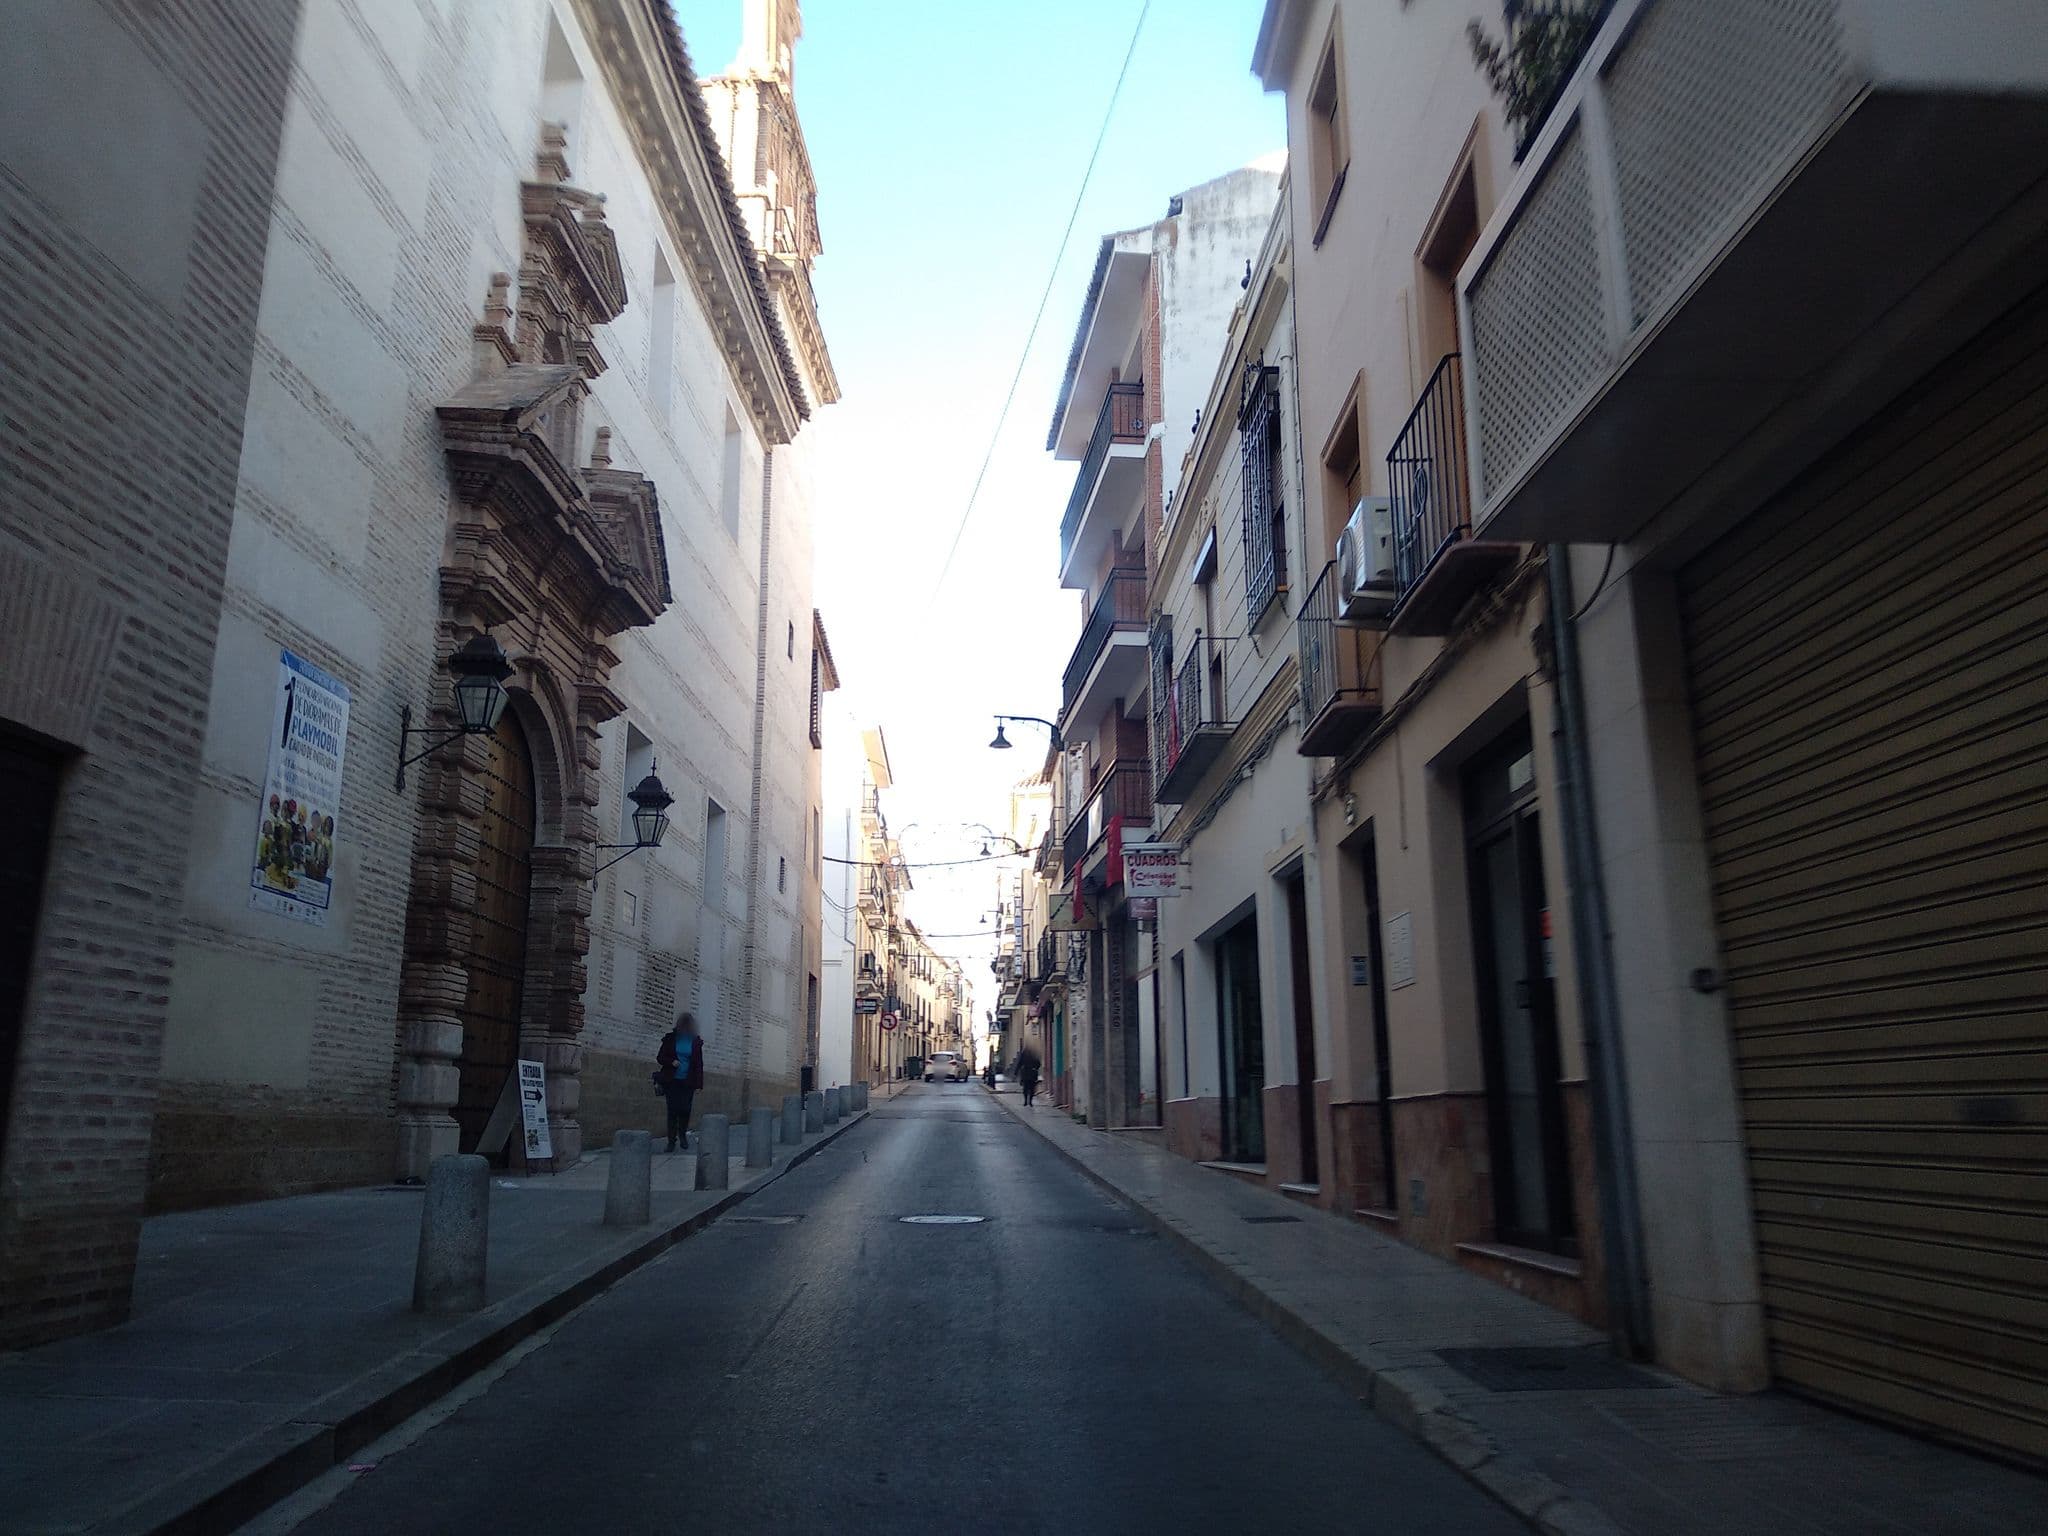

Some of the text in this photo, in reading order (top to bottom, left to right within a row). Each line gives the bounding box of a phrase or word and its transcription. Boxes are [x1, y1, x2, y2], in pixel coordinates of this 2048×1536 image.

[303, 699, 333, 731] DIORAMAS
[292, 715, 338, 756] PLAYMOBIL
[1128, 855, 1176, 866] CUADROS
